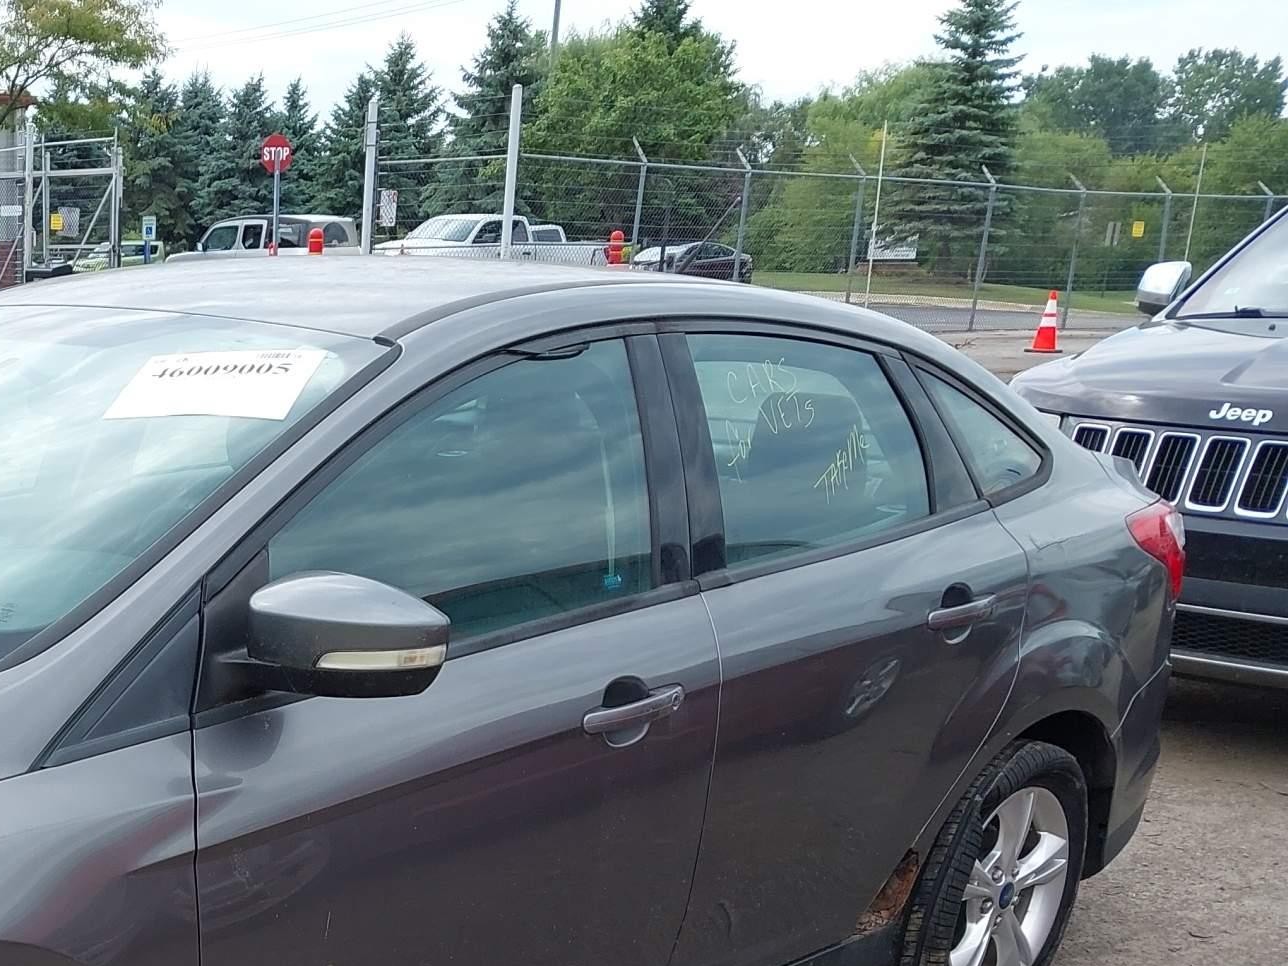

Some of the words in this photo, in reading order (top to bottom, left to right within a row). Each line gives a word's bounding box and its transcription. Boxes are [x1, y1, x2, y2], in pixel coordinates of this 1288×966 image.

[263, 146, 290, 161] STOP
[151, 362, 294, 379] 46009005
[727, 357, 797, 404] CARS
[759, 389, 815, 434] VETS
[1209, 402, 1274, 426] Jeep
